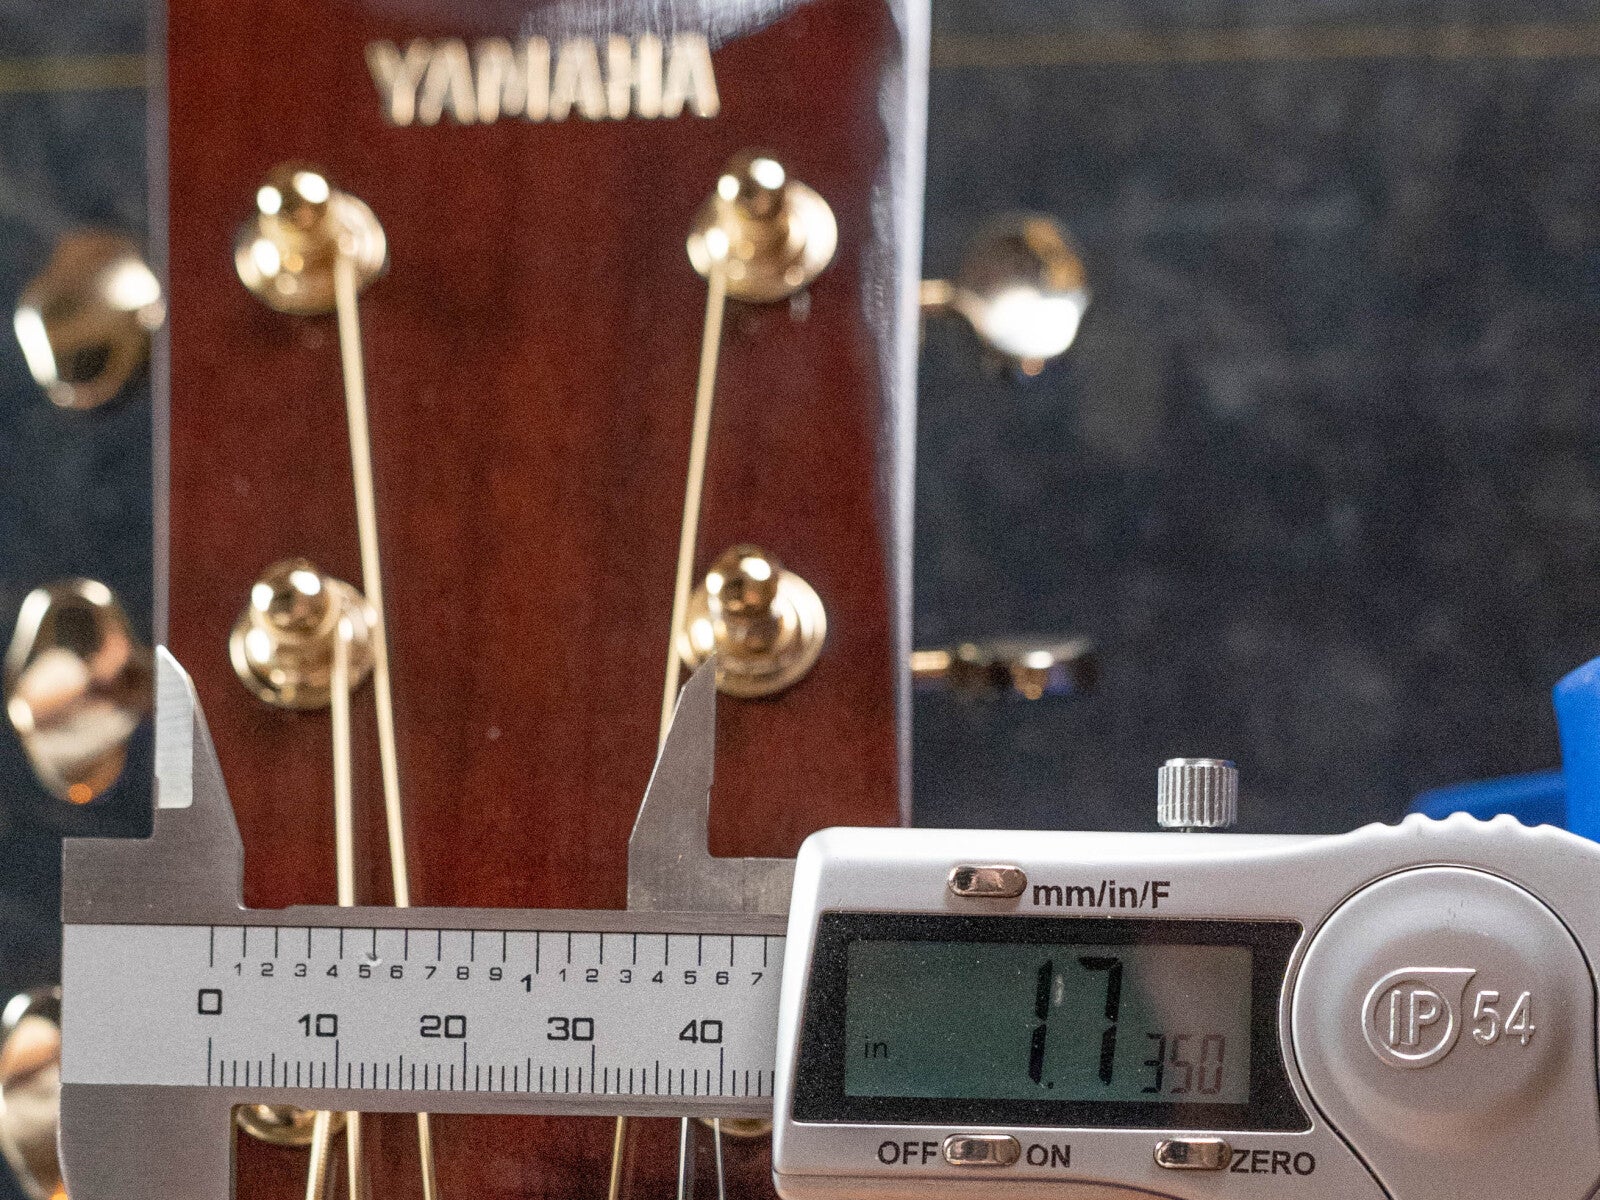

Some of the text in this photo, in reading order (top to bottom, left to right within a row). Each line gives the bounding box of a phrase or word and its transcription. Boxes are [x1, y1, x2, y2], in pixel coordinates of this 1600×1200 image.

[365, 34, 721, 127] YAMAHA
[1032, 880, 1171, 909] mm/in/F
[234, 963, 763, 993] 1 2 3 4 5 6 7 8 9 1 1 2 3 4 5 6 7
[198, 988, 723, 1044] 0 10 20 30 40
[1388, 989, 1535, 1046] IP 54
[863, 1038, 888, 1059] in
[877, 1141, 939, 1165] OFF
[1026, 1144, 1071, 1168] ON
[1230, 1149, 1316, 1176] ZERO
